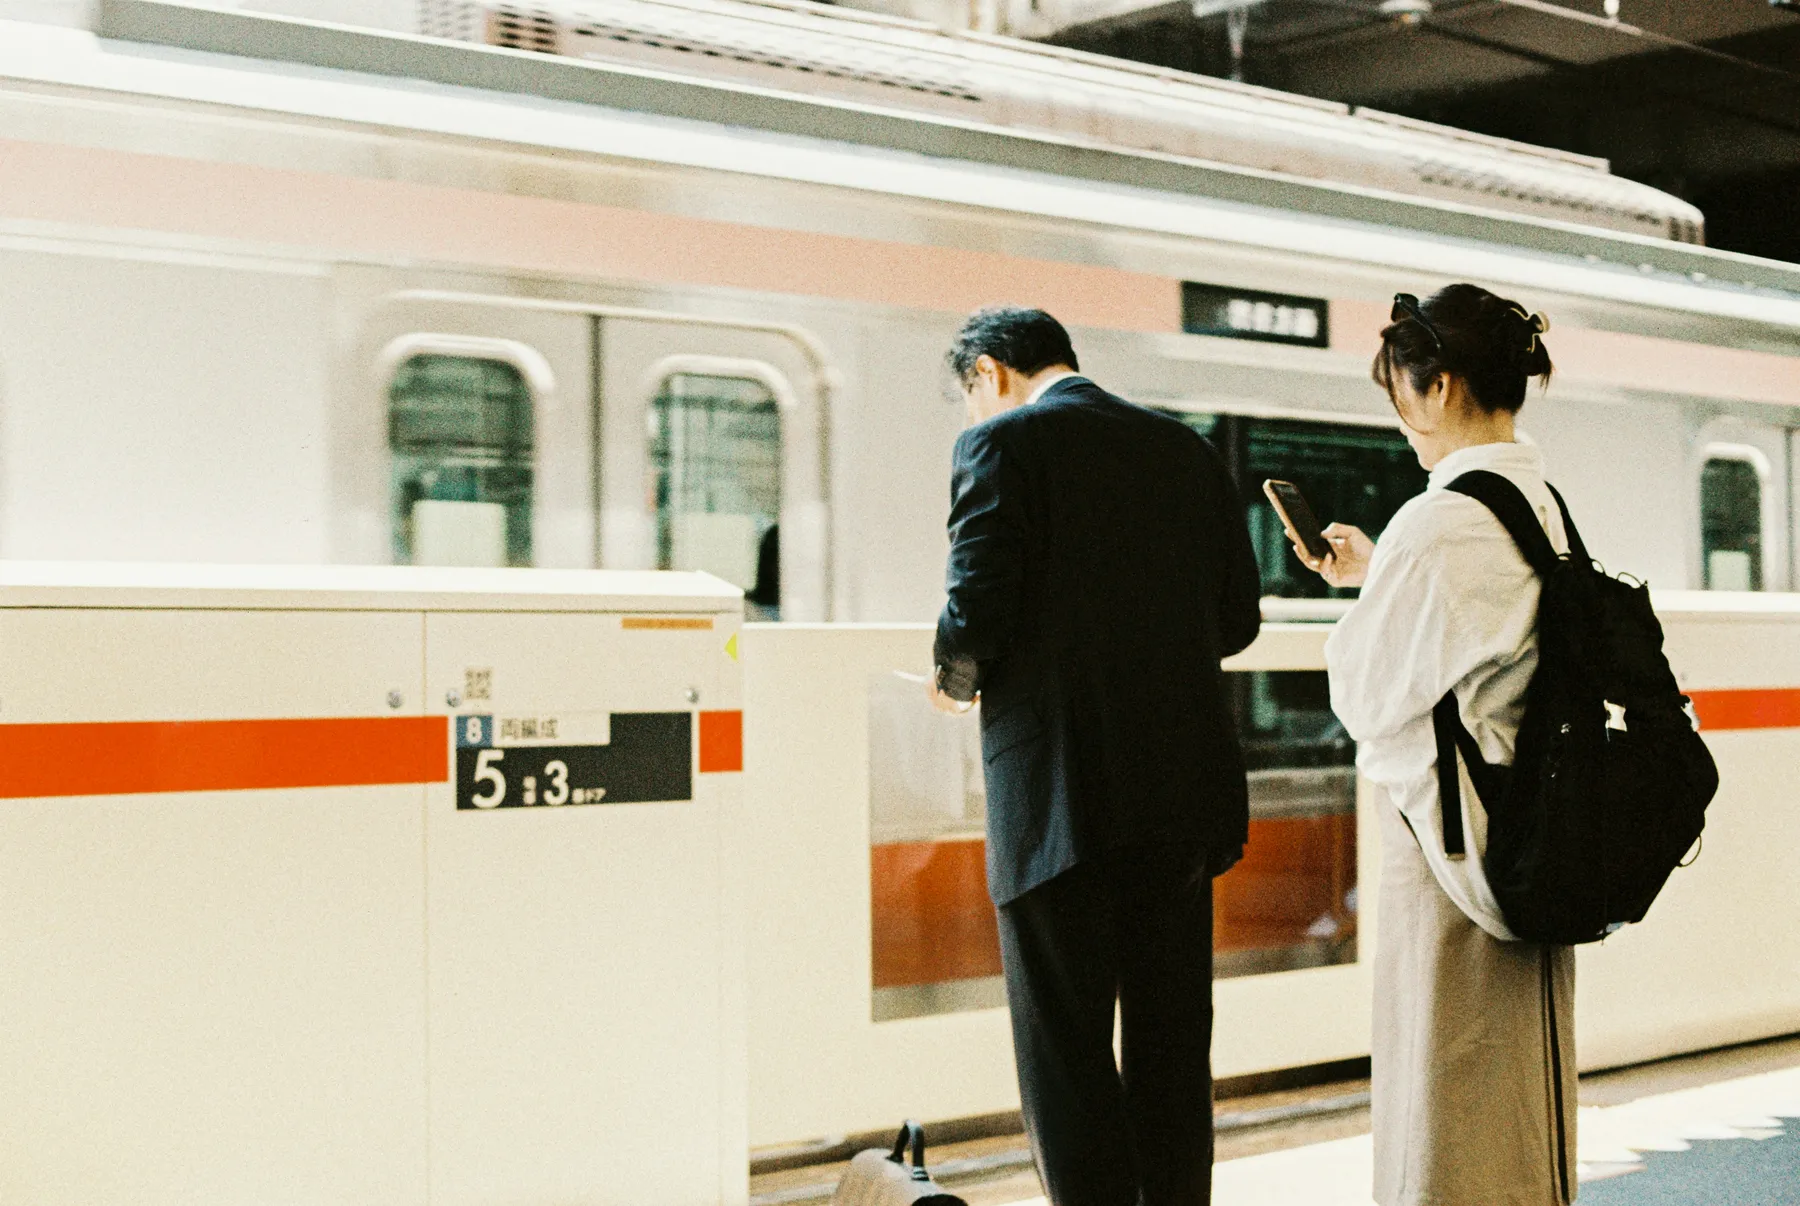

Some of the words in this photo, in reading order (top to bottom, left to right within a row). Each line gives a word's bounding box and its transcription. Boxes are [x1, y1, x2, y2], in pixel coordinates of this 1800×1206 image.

[466, 716, 482, 744] 8
[472, 749, 506, 809] 5
[543, 760, 569, 806] 3
